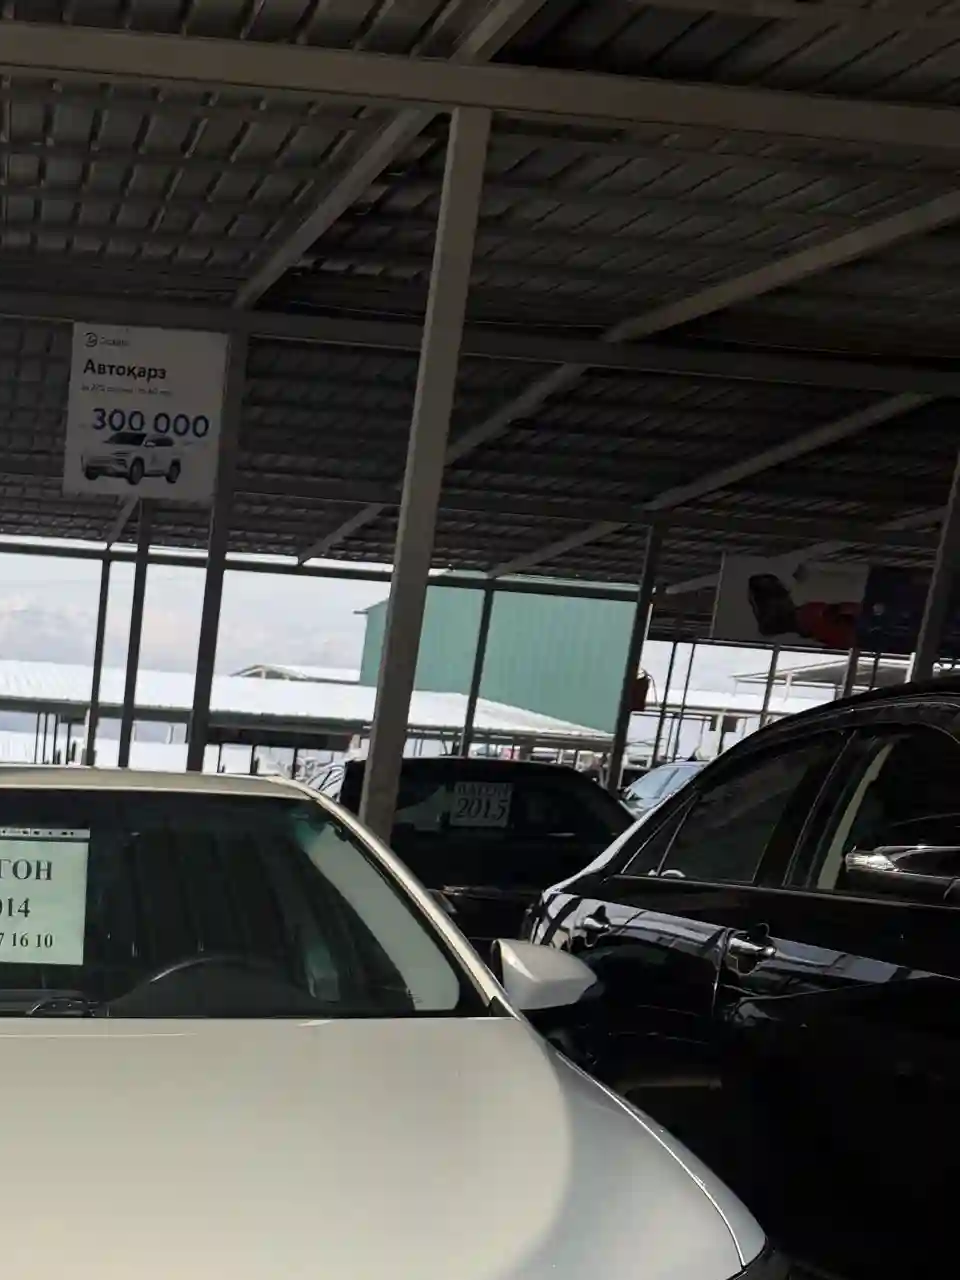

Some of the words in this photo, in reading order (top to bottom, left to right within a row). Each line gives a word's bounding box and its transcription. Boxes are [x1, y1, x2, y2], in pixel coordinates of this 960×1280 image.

[83, 359, 167, 383] Автоқарз
[92, 408, 145, 431] 300
[154, 412, 210, 438] 000
[455, 798, 508, 820] 2015
[11, 932, 29, 947] 16
[35, 933, 54, 948] 10
